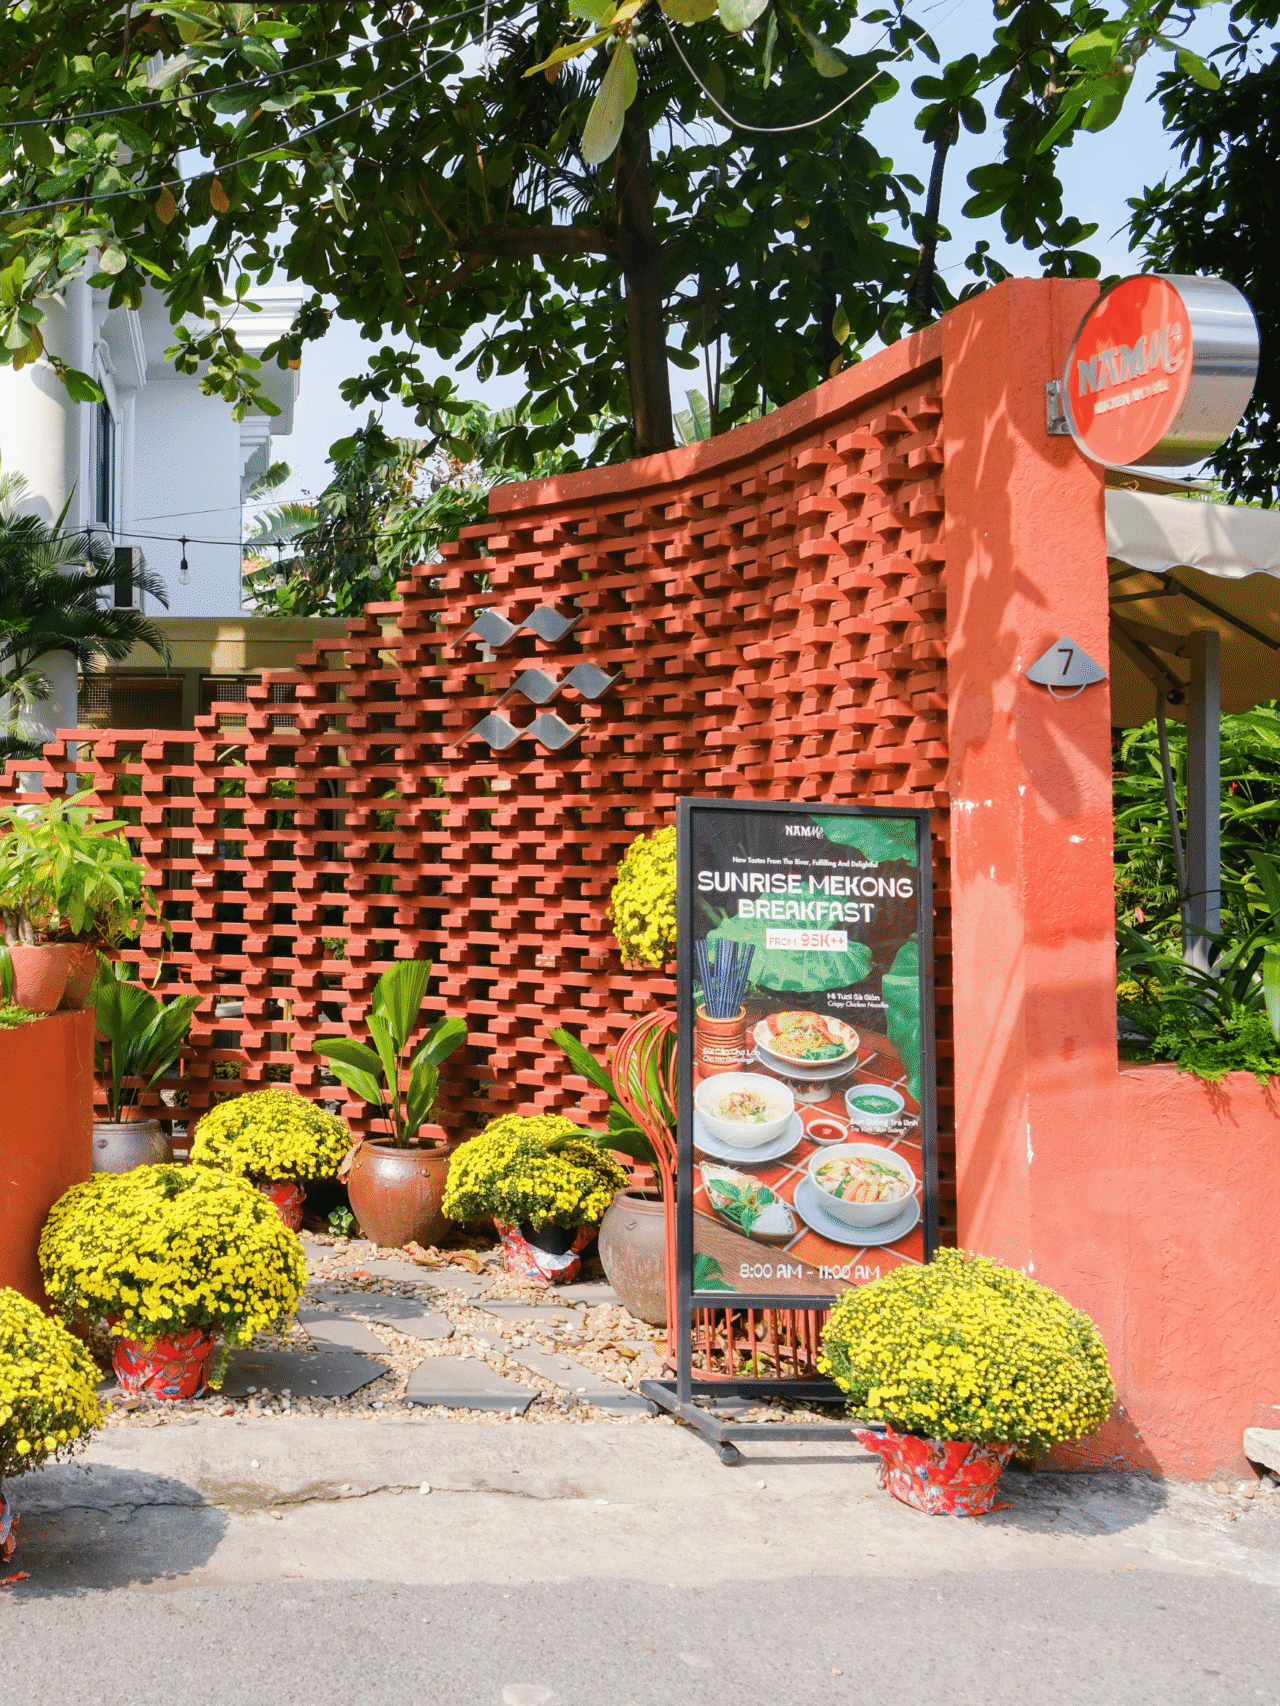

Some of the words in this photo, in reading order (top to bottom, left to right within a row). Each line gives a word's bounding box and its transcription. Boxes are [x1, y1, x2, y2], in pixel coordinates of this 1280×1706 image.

[1057, 648, 1074, 676] 7
[747, 856, 766, 864] Tastes
[782, 857, 793, 865] The
[837, 859, 850, 867] And
[697, 871, 803, 894] SUNRISE
[808, 875, 914, 898] MEKONG
[738, 898, 875, 922] BREAKFAST
[769, 937, 797, 946] FROM
[801, 933, 845, 947] 95K++
[739, 1263, 773, 1279] 8:00
[776, 1263, 803, 1279] AM
[818, 1264, 851, 1279] 11:00
[854, 1265, 880, 1280] AM
